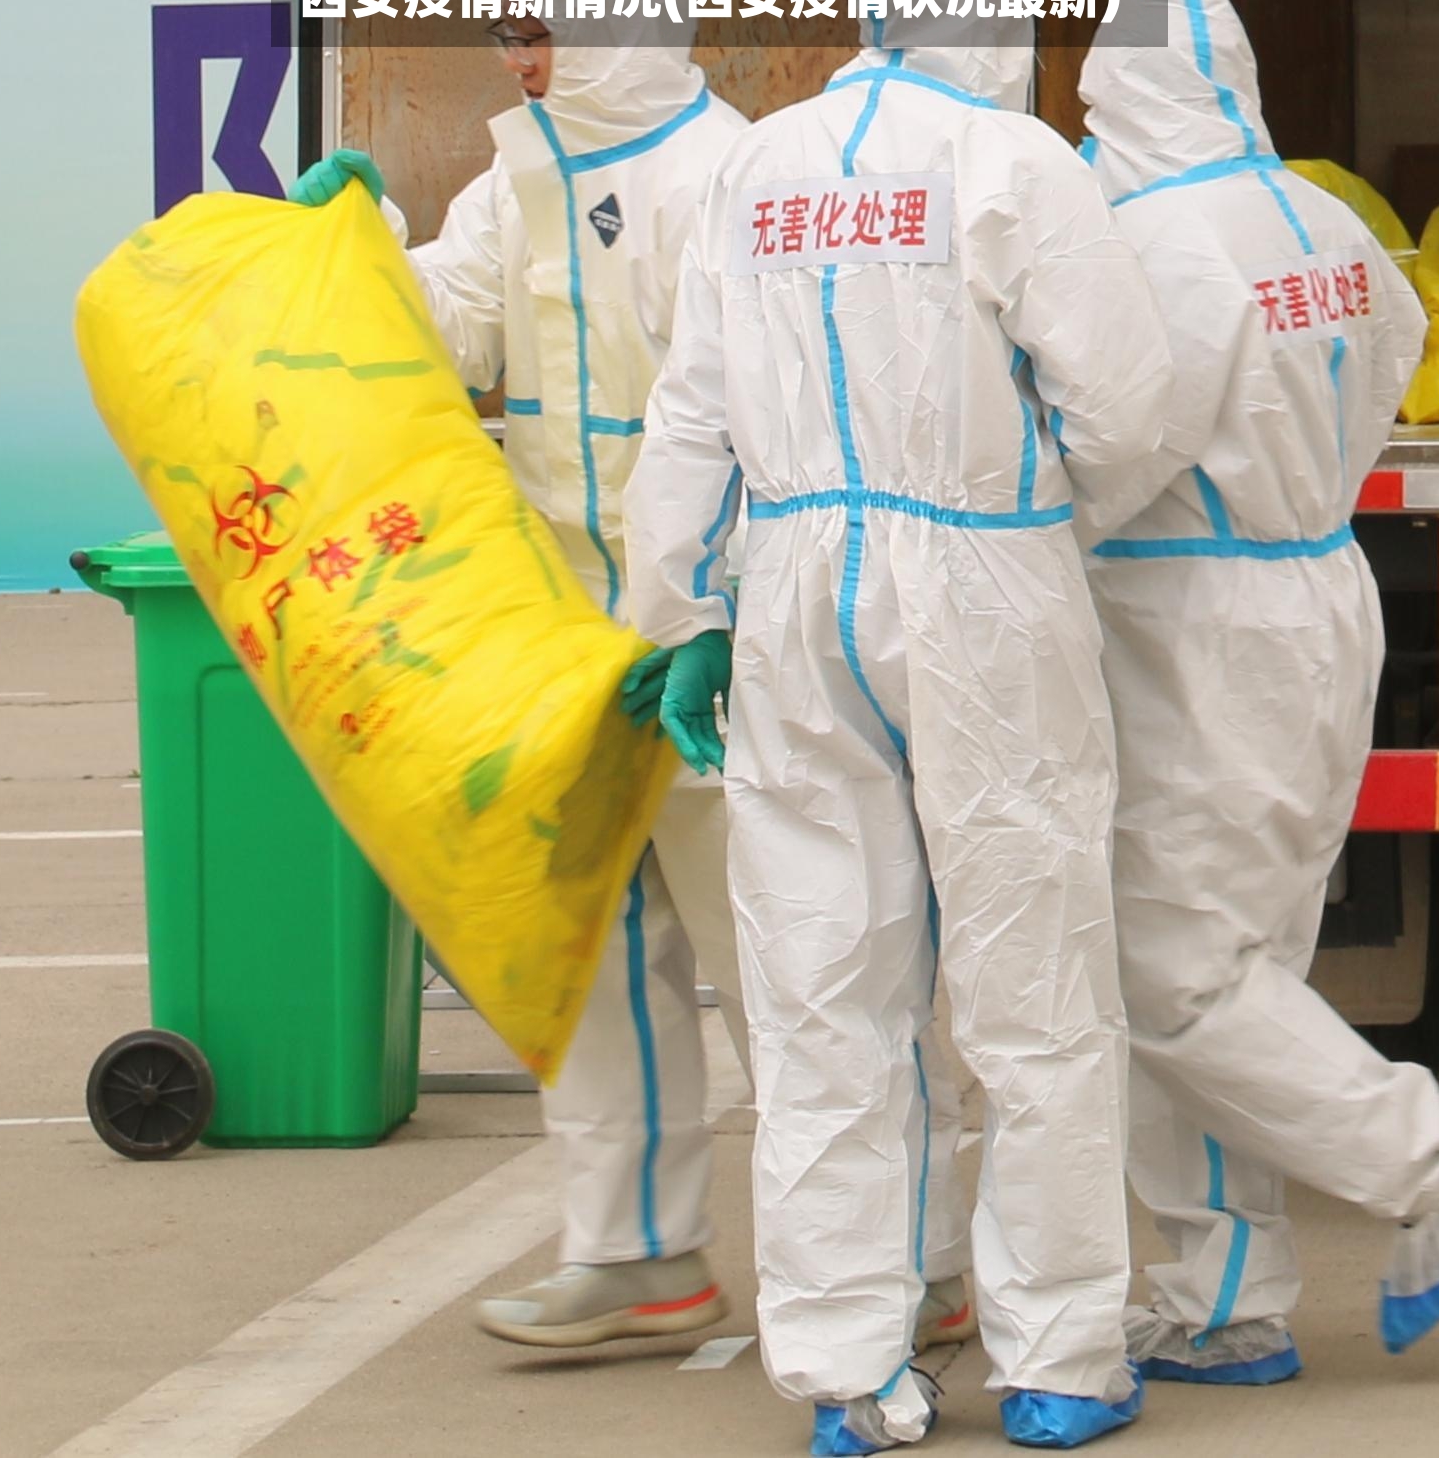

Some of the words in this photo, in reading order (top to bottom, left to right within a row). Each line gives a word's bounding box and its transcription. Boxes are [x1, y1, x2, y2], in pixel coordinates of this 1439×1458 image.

[751, 189, 928, 257] 无害化处理
[1254, 261, 1371, 334] 无害化处理
